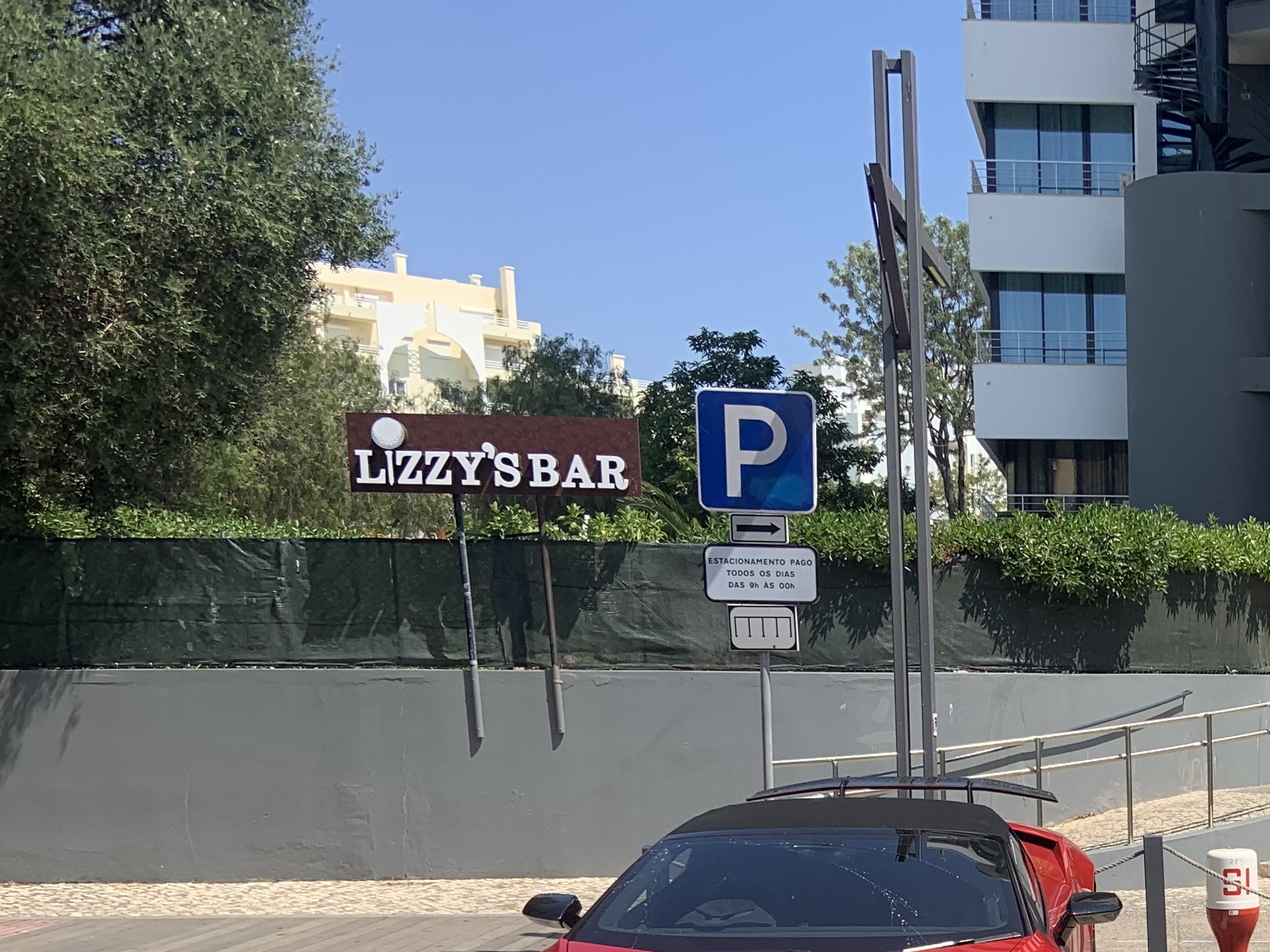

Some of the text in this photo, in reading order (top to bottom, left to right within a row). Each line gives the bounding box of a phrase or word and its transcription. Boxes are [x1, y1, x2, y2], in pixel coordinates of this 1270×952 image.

[724, 404, 787, 497] P
[527, 453, 629, 490] BAR
[708, 557, 813, 567] ESTACIONAMENTO PAGO
[726, 569, 755, 577] TODOS
[775, 570, 796, 578] DIAS
[728, 581, 745, 589] DAS
[763, 581, 775, 589] ÀS
